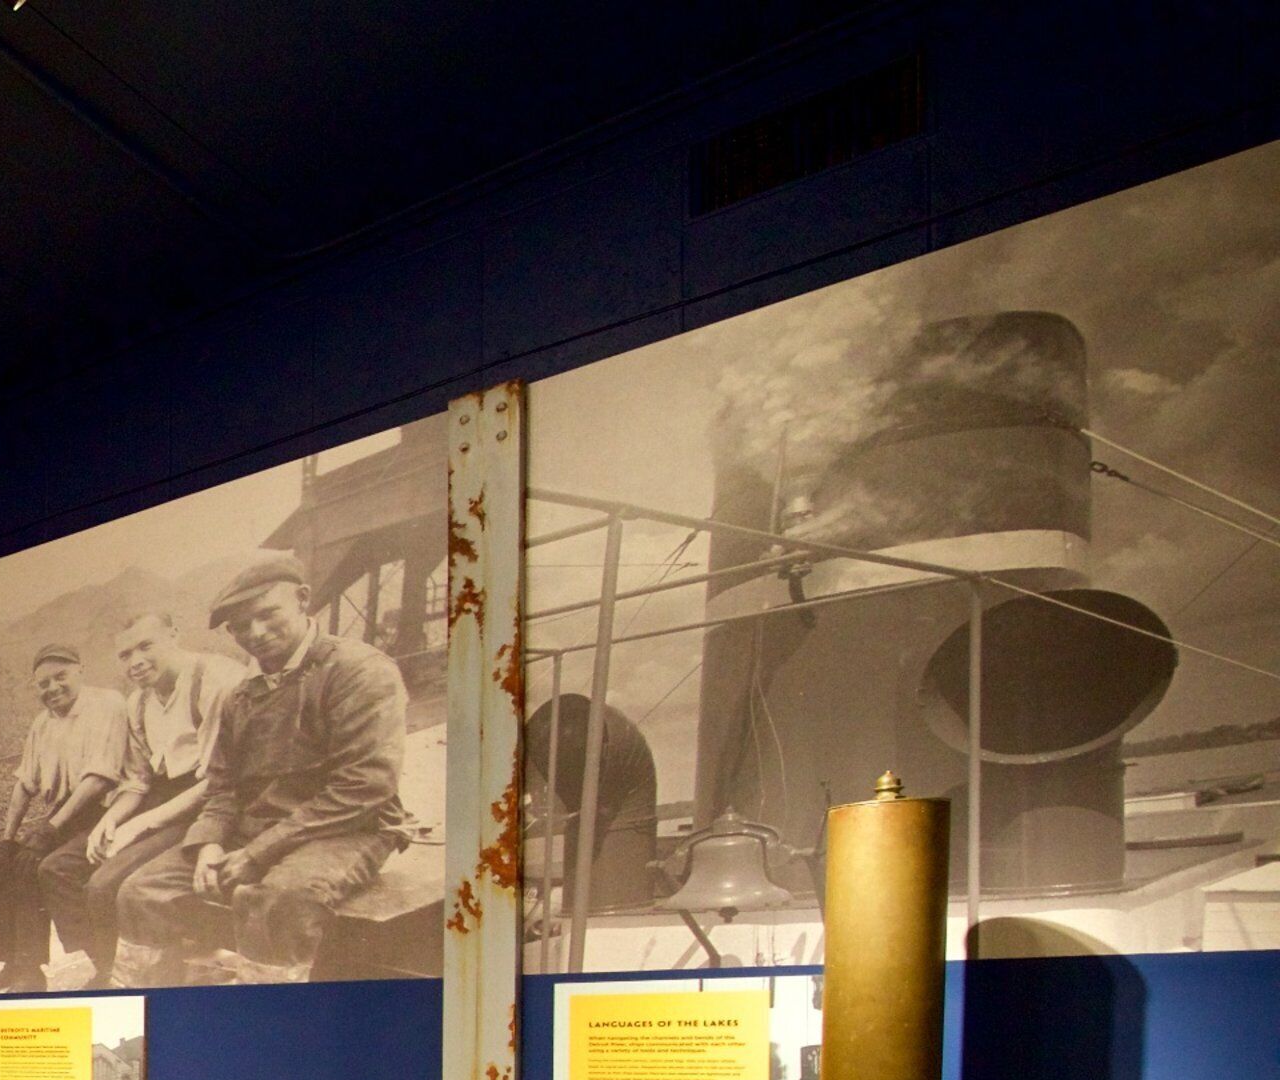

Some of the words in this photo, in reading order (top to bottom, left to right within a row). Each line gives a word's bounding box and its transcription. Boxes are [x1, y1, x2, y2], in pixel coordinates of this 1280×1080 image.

[588, 1020, 653, 1028] LANGUAGES
[657, 1020, 671, 1028] OF
[703, 1019, 739, 1027] LAKES
